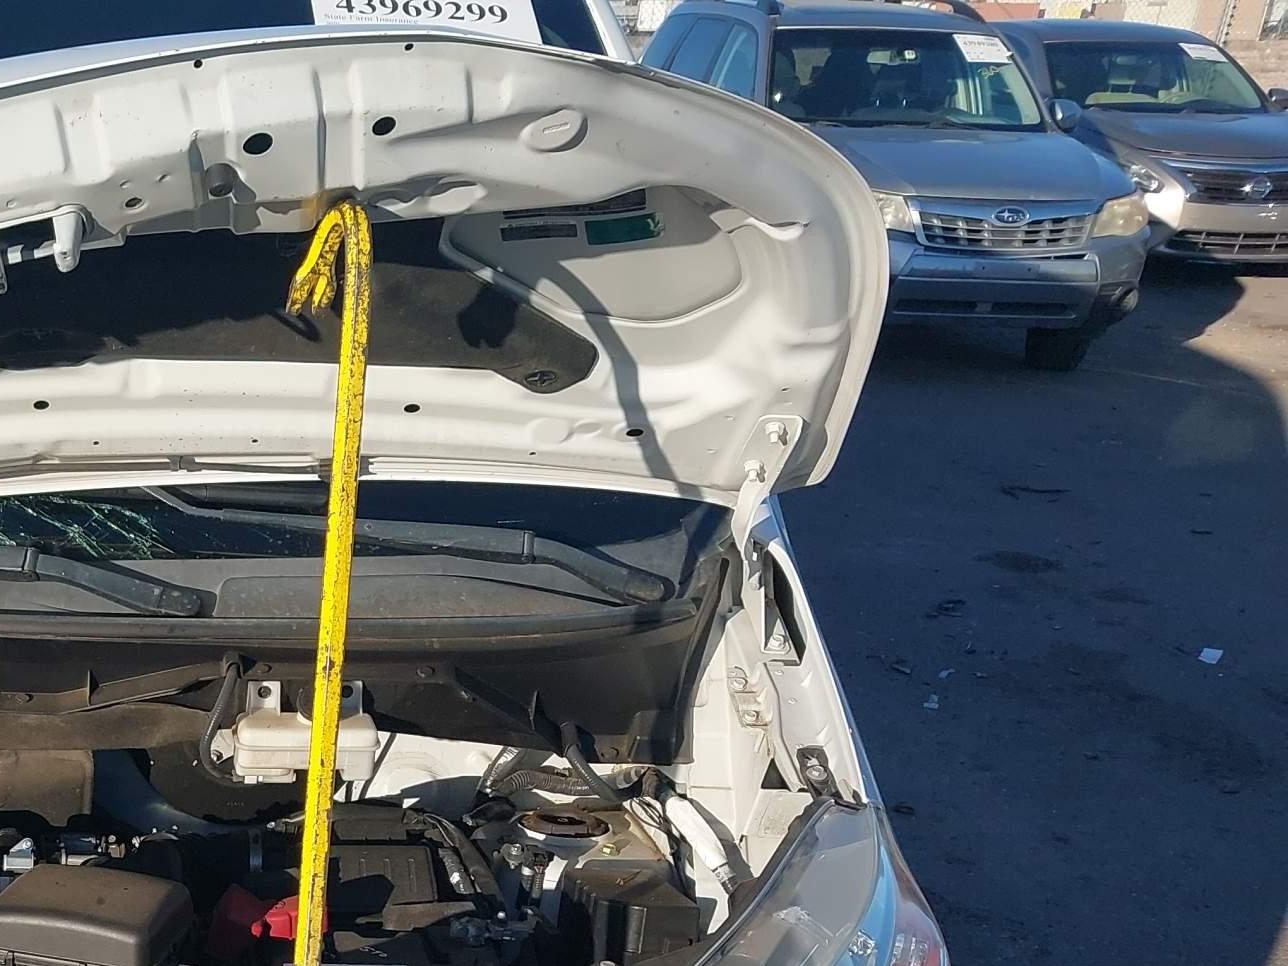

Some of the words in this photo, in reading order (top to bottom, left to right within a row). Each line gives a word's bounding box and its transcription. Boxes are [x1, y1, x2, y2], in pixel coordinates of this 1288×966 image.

[335, 0, 508, 24] 43969299
[349, 14, 373, 22] Farm
[375, 16, 419, 24] Insurance
